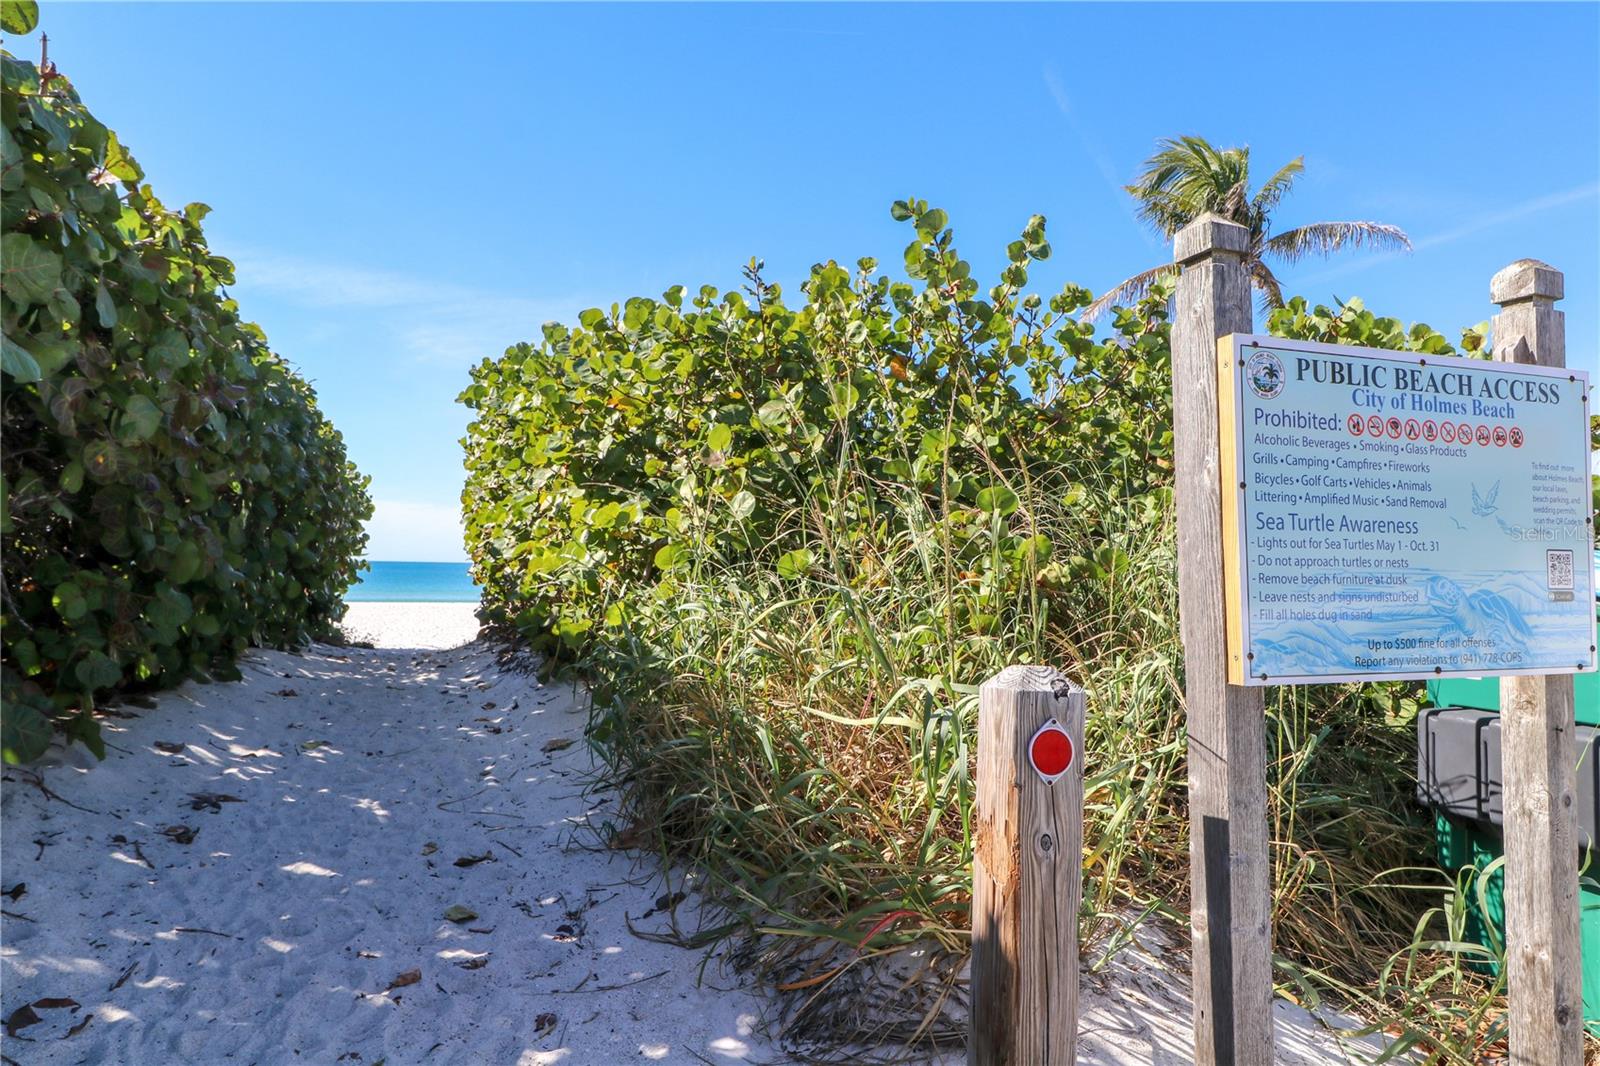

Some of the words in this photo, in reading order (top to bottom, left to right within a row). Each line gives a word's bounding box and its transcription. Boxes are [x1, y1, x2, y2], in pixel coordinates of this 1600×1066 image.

[1296, 358, 1387, 388] PUBLIC
[1394, 368, 1473, 396] BEACH
[1479, 378, 1560, 404] ACCESS
[1352, 388, 1385, 412] City
[1391, 392, 1407, 409] of
[1411, 394, 1467, 415] Holmes
[1472, 399, 1515, 419] Beach
[1254, 408, 1342, 431] Prohibited:
[1254, 433, 1300, 447] Alcoholic
[1302, 436, 1350, 452] Beverages
[1360, 440, 1399, 456] Smoking
[1405, 443, 1428, 455] Glass
[1430, 445, 1467, 457] Products
[1253, 452, 1278, 464] Grills
[1285, 454, 1329, 470] Camping
[1336, 457, 1382, 472] Campfires
[1388, 460, 1430, 473] Fireworks
[1255, 472, 1294, 487] Bicycles
[1301, 475, 1321, 486] Golf
[1323, 475, 1347, 488] Carts
[1353, 478, 1390, 490] Vehicles
[1397, 480, 1432, 492] Animals
[1255, 490, 1297, 505] Littering
[1304, 492, 1350, 506] Amplified
[1353, 494, 1379, 506] Music
[1386, 496, 1408, 507] Sand
[1410, 497, 1447, 508] Removal
[1256, 512, 1284, 530] Sea
[1288, 513, 1334, 532] Turtle
[1339, 515, 1418, 534] Awareness
[1257, 537, 1287, 551] Lights
[1290, 540, 1306, 549] out
[1309, 537, 1322, 549] for
[1325, 538, 1341, 550] Sea
[1343, 538, 1374, 550] Turtles
[1376, 540, 1395, 553] May
[1398, 540, 1402, 550] 1
[1410, 540, 1428, 551] Oct.
[1430, 541, 1439, 551] 31
[1258, 555, 1272, 566] Do
[1275, 557, 1292, 566] not
[1294, 556, 1340, 569] approach
[1342, 556, 1372, 567] turtles
[1374, 559, 1384, 567] or
[1386, 558, 1409, 568] nests
[1258, 573, 1299, 584] Remove
[1301, 574, 1330, 584] beach
[1332, 573, 1373, 584] furniture
[1375, 576, 1384, 584] at
[1386, 574, 1407, 584] dusk
[1259, 591, 1287, 602] Leave
[1290, 592, 1316, 602] nests
[1318, 592, 1336, 602] and
[1338, 592, 1363, 605] signs
[1364, 592, 1419, 602] undisturbed
[1260, 609, 1273, 620] Fill
[1276, 609, 1287, 620] all
[1290, 609, 1315, 620] holes
[1318, 609, 1337, 622] dug
[1340, 610, 1350, 620] in
[1351, 609, 1373, 620] sand
[1367, 639, 1381, 652] Up
[1383, 640, 1393, 650] to
[1395, 638, 1416, 650] $500
[1418, 638, 1435, 649] fine
[1436, 638, 1448, 649] for
[1450, 638, 1460, 648] all
[1461, 638, 1496, 648] offenses
[1355, 656, 1386, 668] Report
[1388, 657, 1404, 668] any
[1406, 655, 1448, 666] violations
[1449, 655, 1458, 664] to
[1460, 653, 1480, 665] (941)
